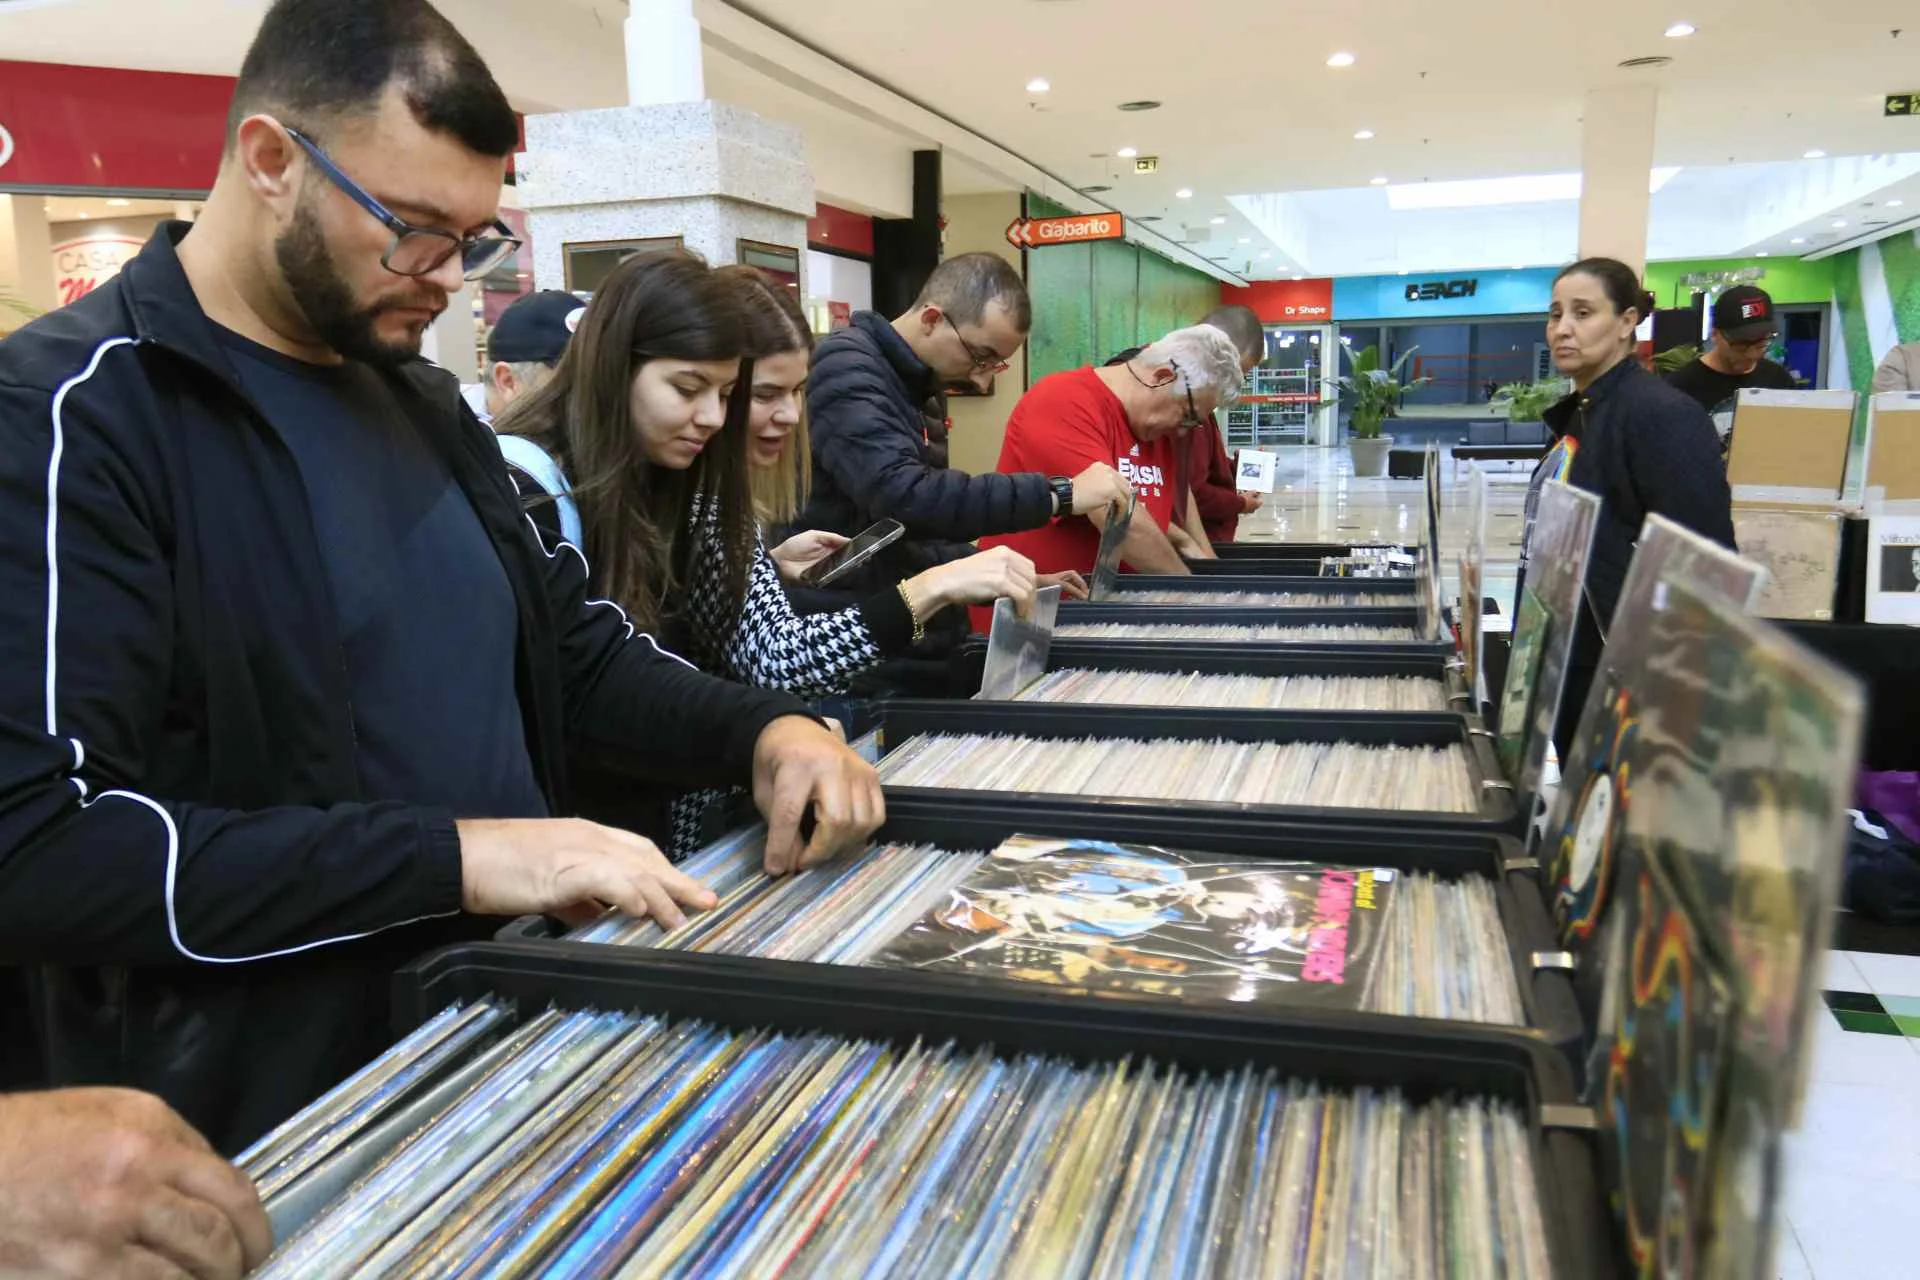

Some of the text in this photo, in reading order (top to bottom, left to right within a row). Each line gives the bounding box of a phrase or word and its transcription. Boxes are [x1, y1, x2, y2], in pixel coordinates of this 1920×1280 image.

[58, 250, 119, 273] CASA
[1285, 305, 1326, 316] Dr Shape
